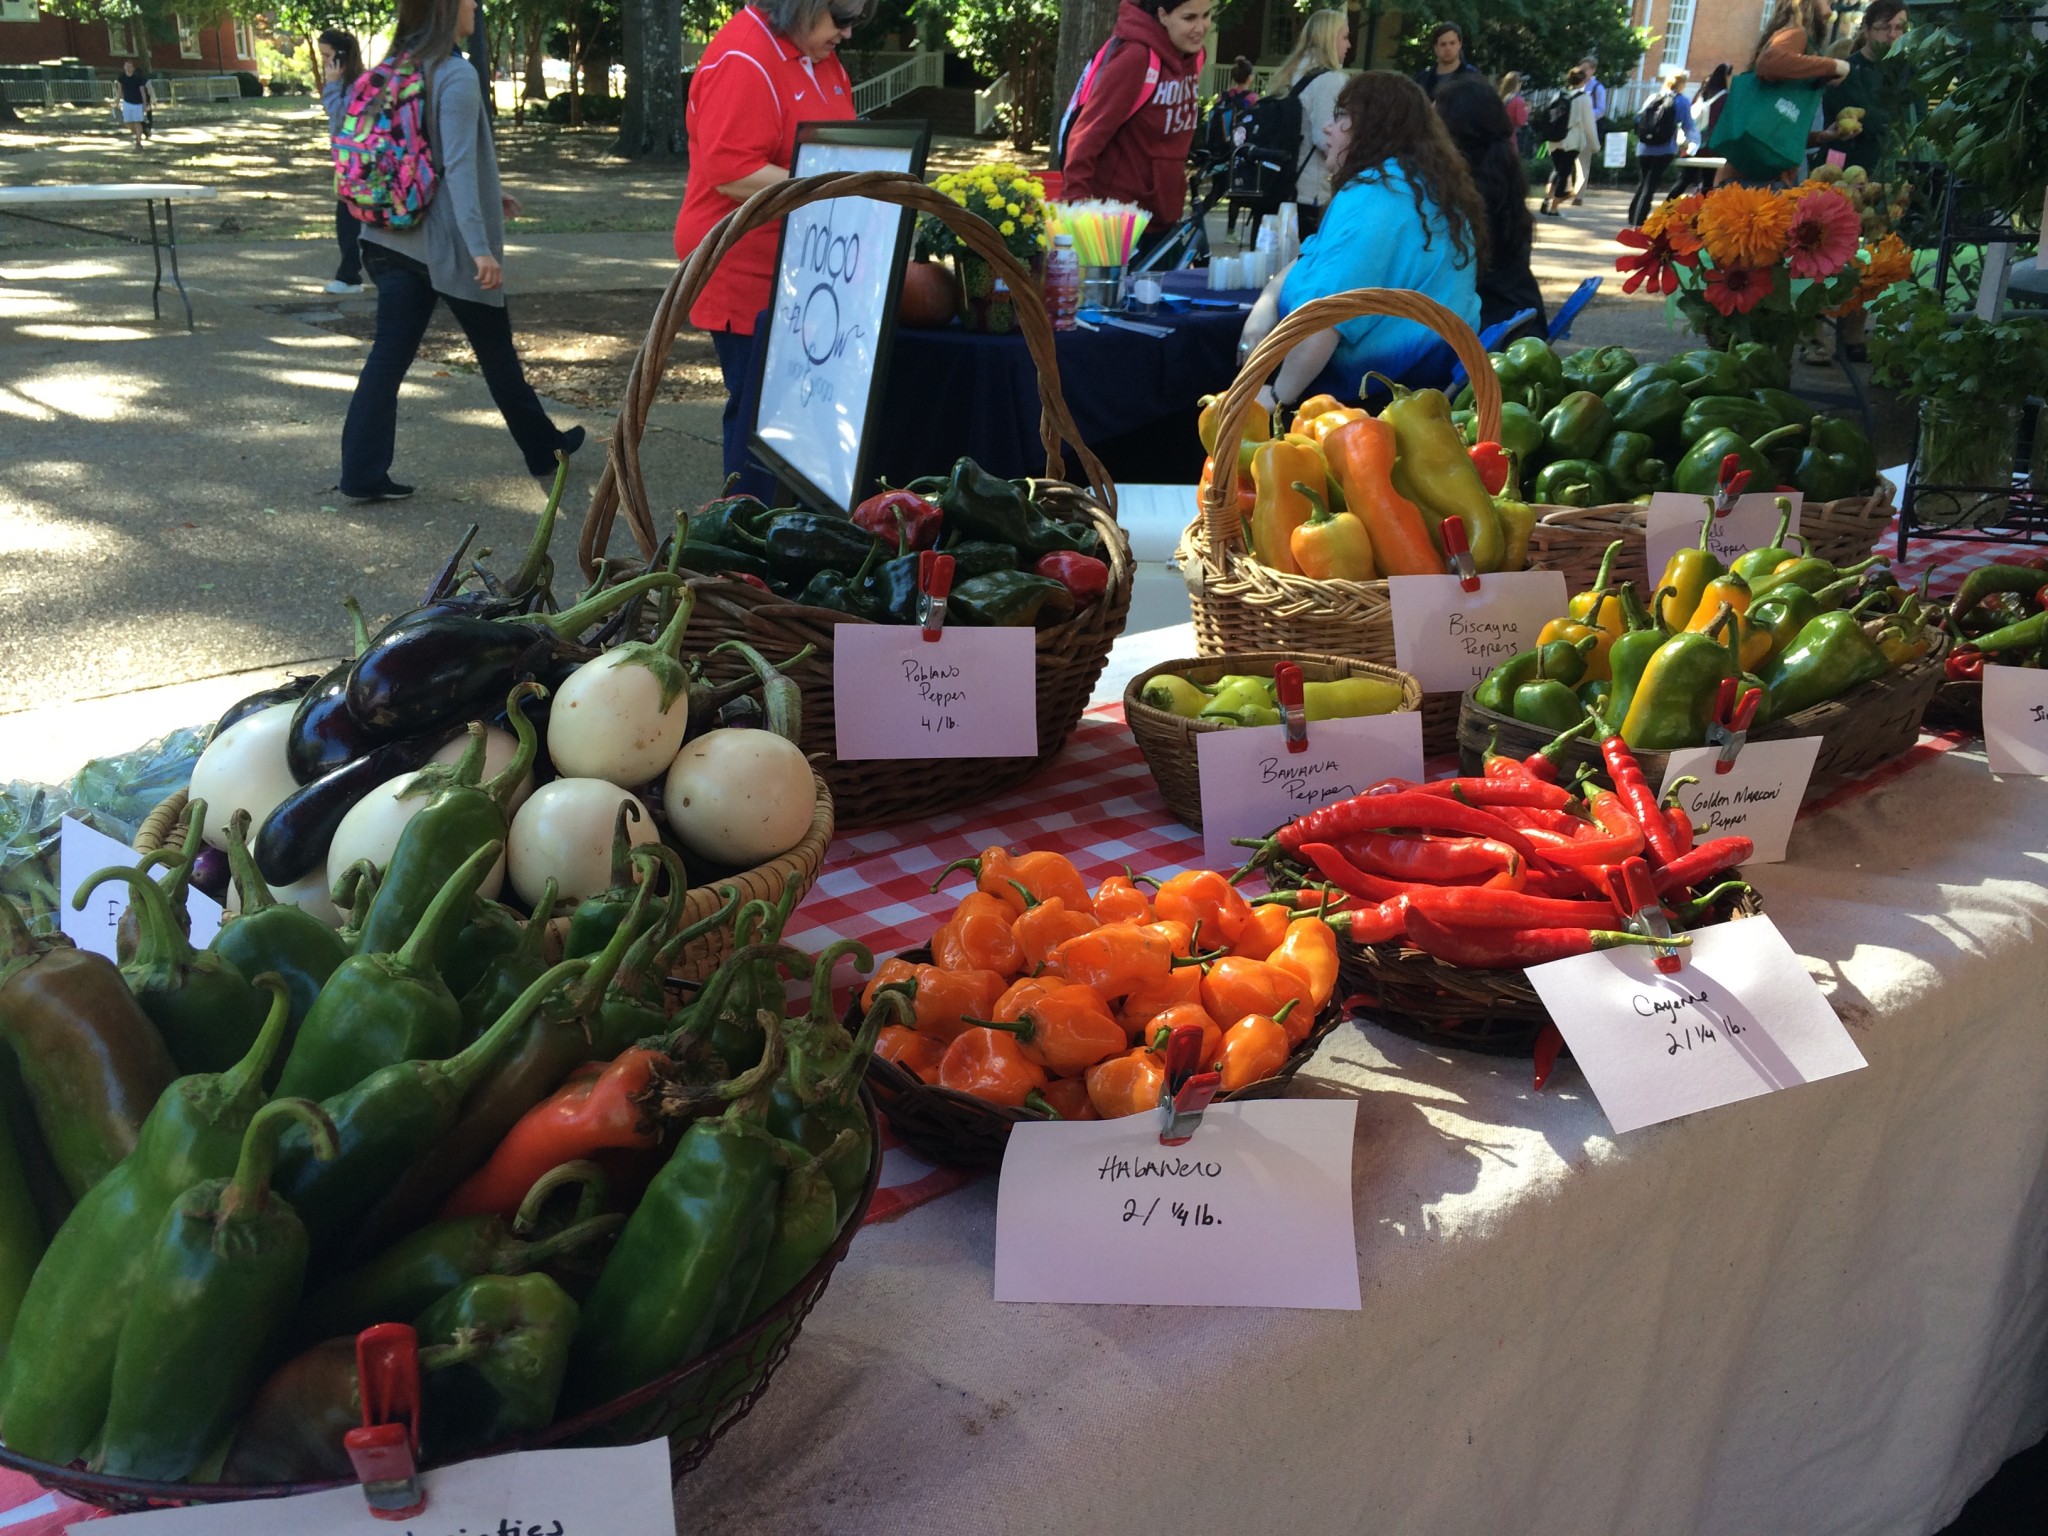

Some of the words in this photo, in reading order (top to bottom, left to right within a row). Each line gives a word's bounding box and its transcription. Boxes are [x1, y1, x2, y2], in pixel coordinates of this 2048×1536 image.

[918, 681, 966, 707] Pepper
[1281, 778, 1356, 805] Pepper
[1691, 790, 1730, 812] Golden
[1709, 810, 1747, 831] Pepper
